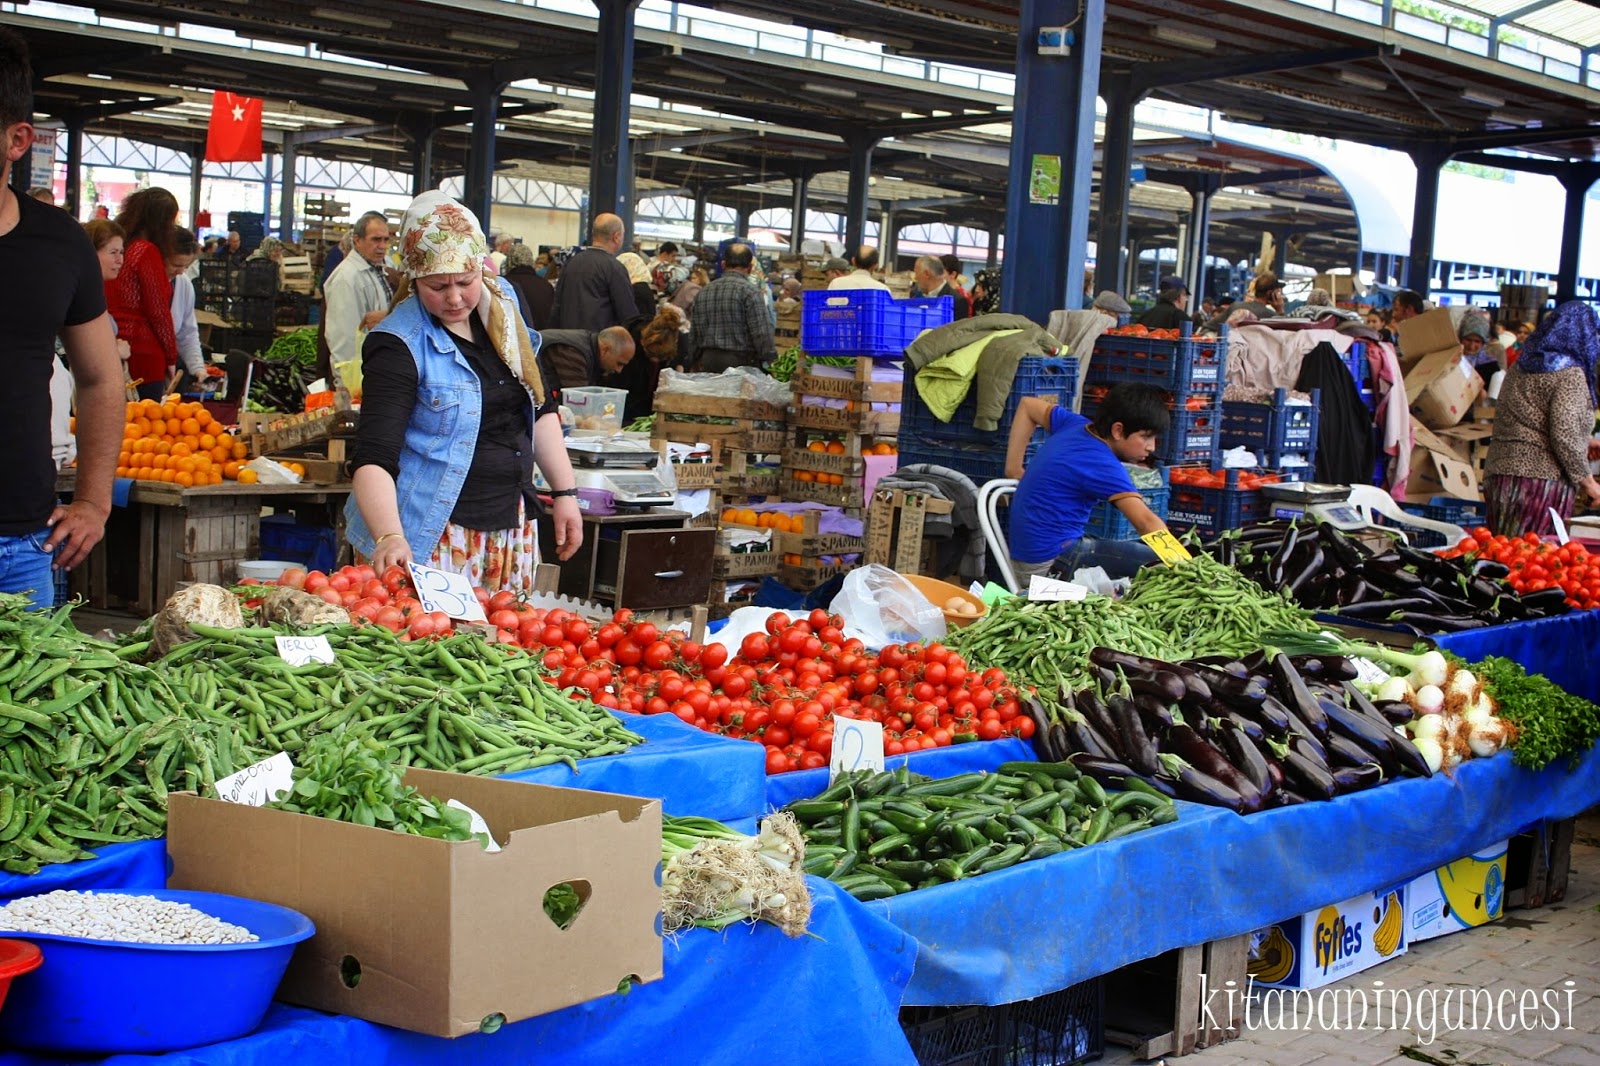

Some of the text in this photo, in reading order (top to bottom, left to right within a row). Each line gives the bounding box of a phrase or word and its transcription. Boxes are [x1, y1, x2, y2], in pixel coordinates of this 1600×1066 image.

[801, 377, 854, 394] S.PAMUK
[734, 553, 778, 569] S.PAMUK
[424, 570, 467, 617] 3
[458, 592, 478, 604] TL
